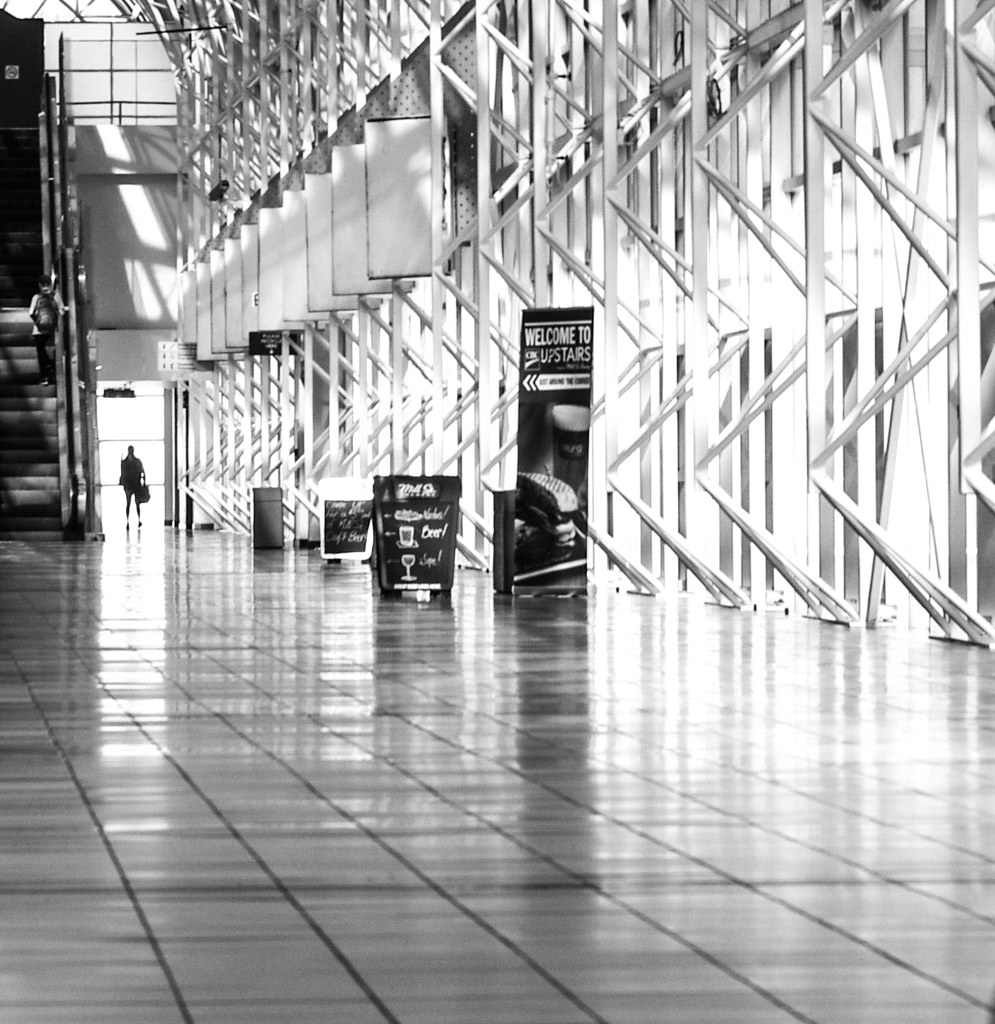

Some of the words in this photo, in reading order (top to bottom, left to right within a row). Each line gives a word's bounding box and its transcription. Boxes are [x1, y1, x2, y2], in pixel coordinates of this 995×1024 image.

[525, 327, 576, 346] WELCOME
[578, 326, 591, 344] TO
[541, 346, 591, 363] UPSTAIRS
[421, 522, 449, 540] Beer!
